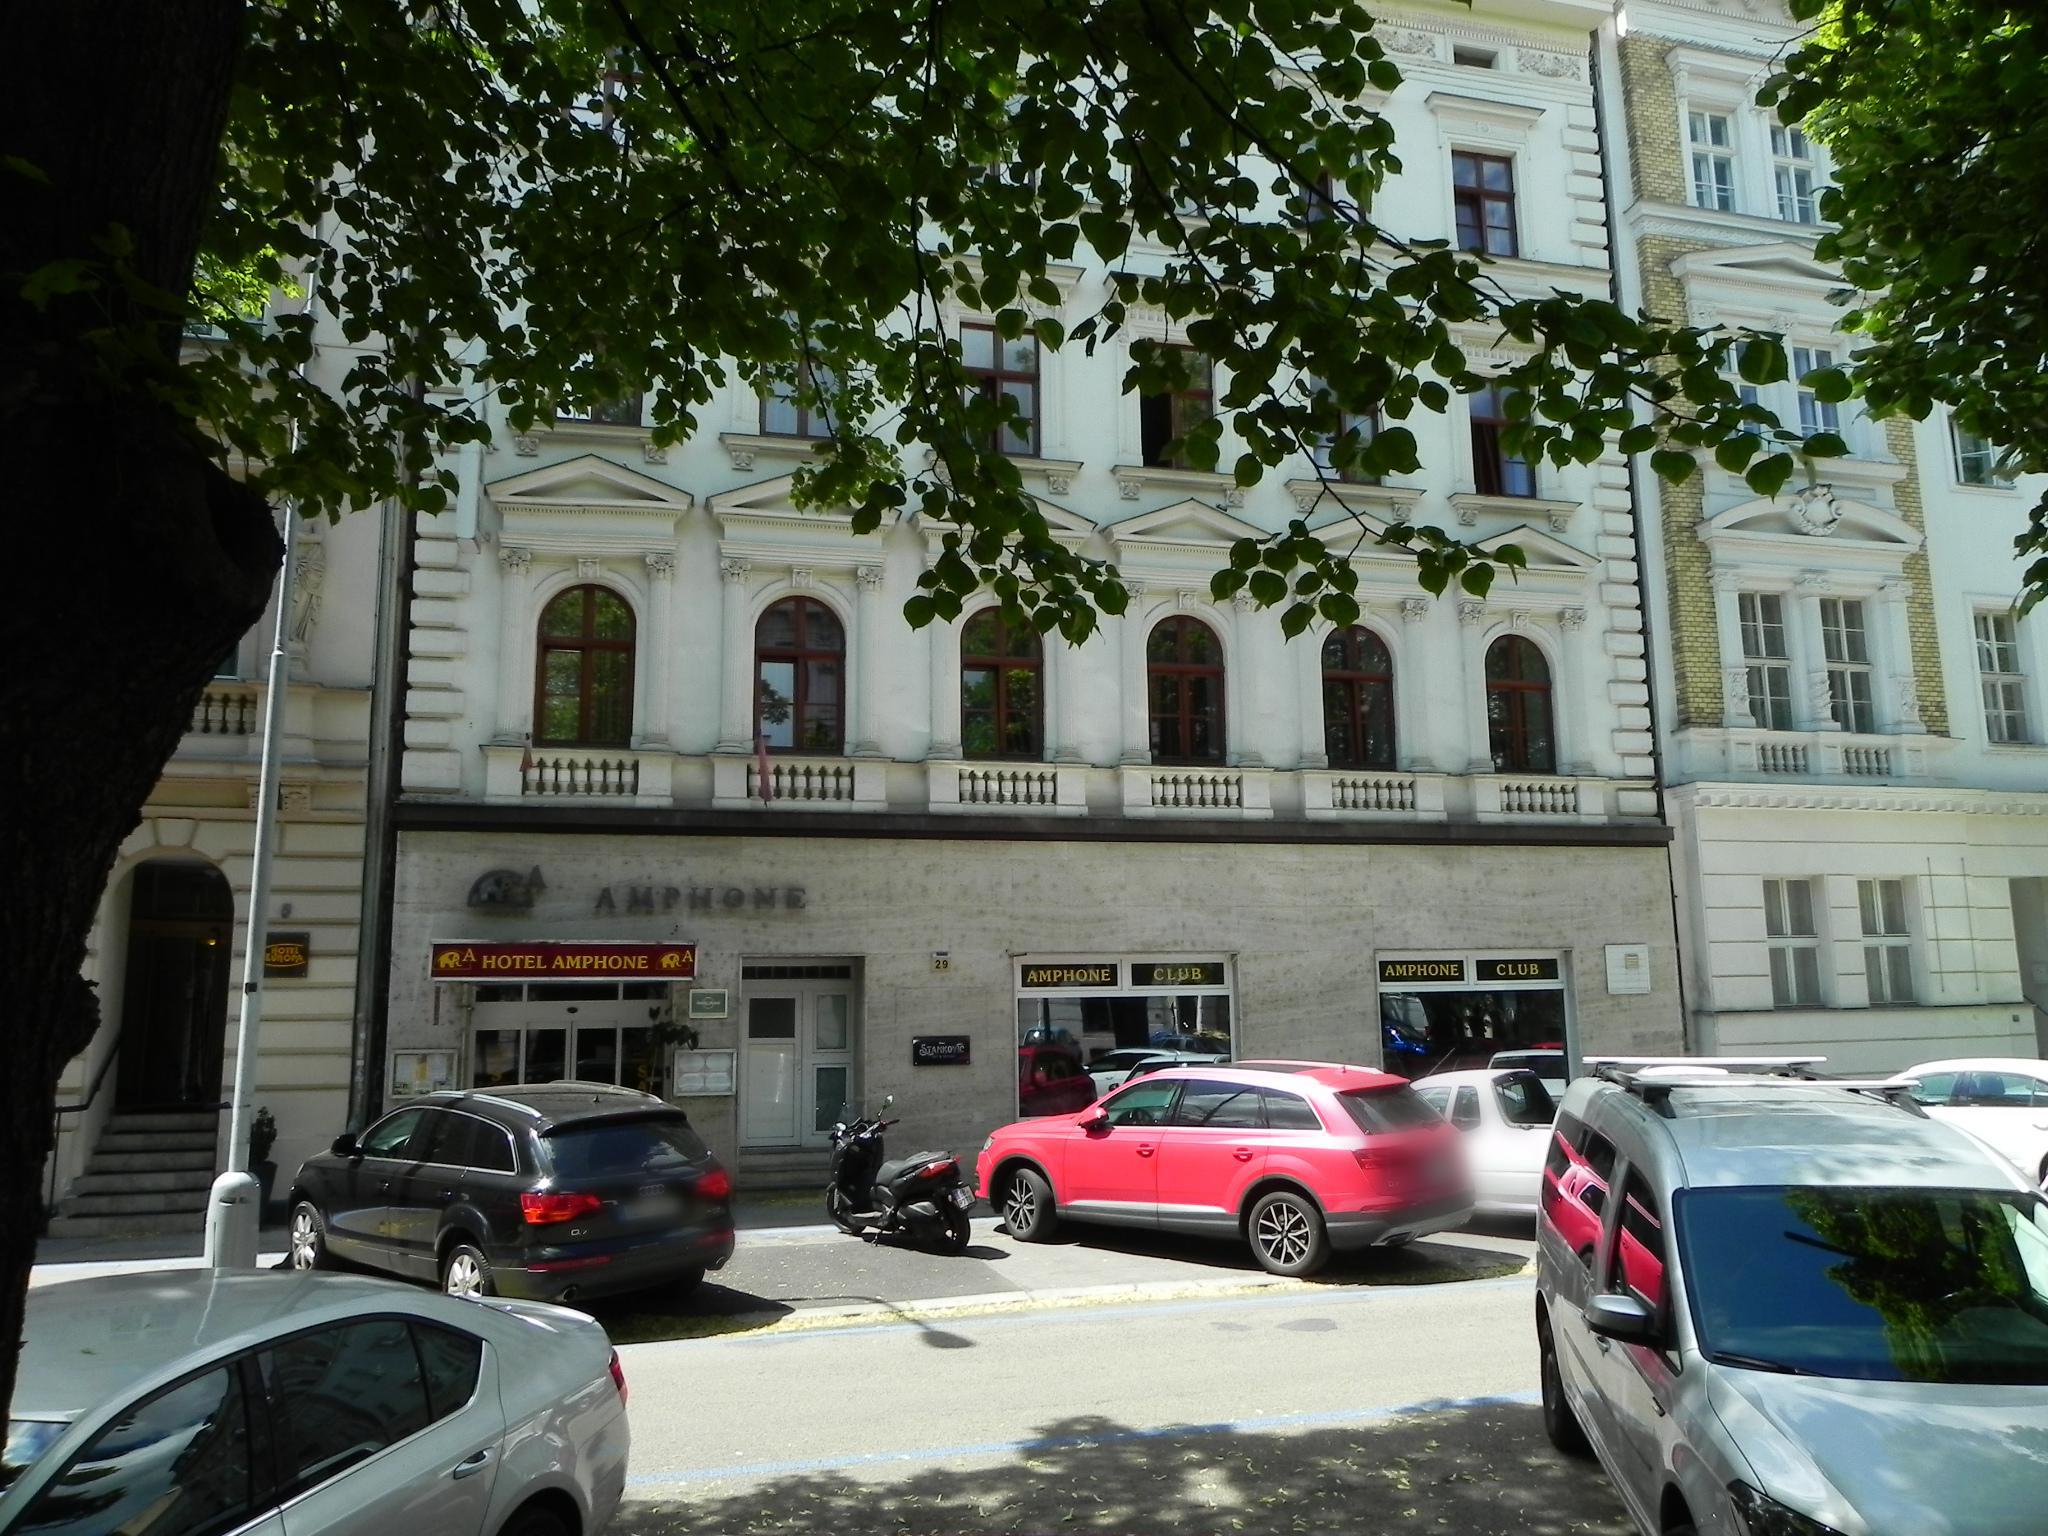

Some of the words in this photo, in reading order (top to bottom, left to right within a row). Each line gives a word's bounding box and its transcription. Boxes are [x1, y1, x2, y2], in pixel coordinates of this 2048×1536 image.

[594, 885, 808, 911] AMPHONE
[271, 946, 299, 955] HOTEL
[462, 948, 477, 963] A
[681, 949, 694, 963] A
[482, 955, 547, 970] HOTEL
[551, 955, 649, 970] AMPHONE
[935, 959, 949, 969] 29
[1027, 968, 1112, 983] AMPHONE
[1153, 967, 1202, 981] CLUB
[1385, 964, 1459, 977] AMPHONE
[1496, 963, 1540, 976] CLUB
